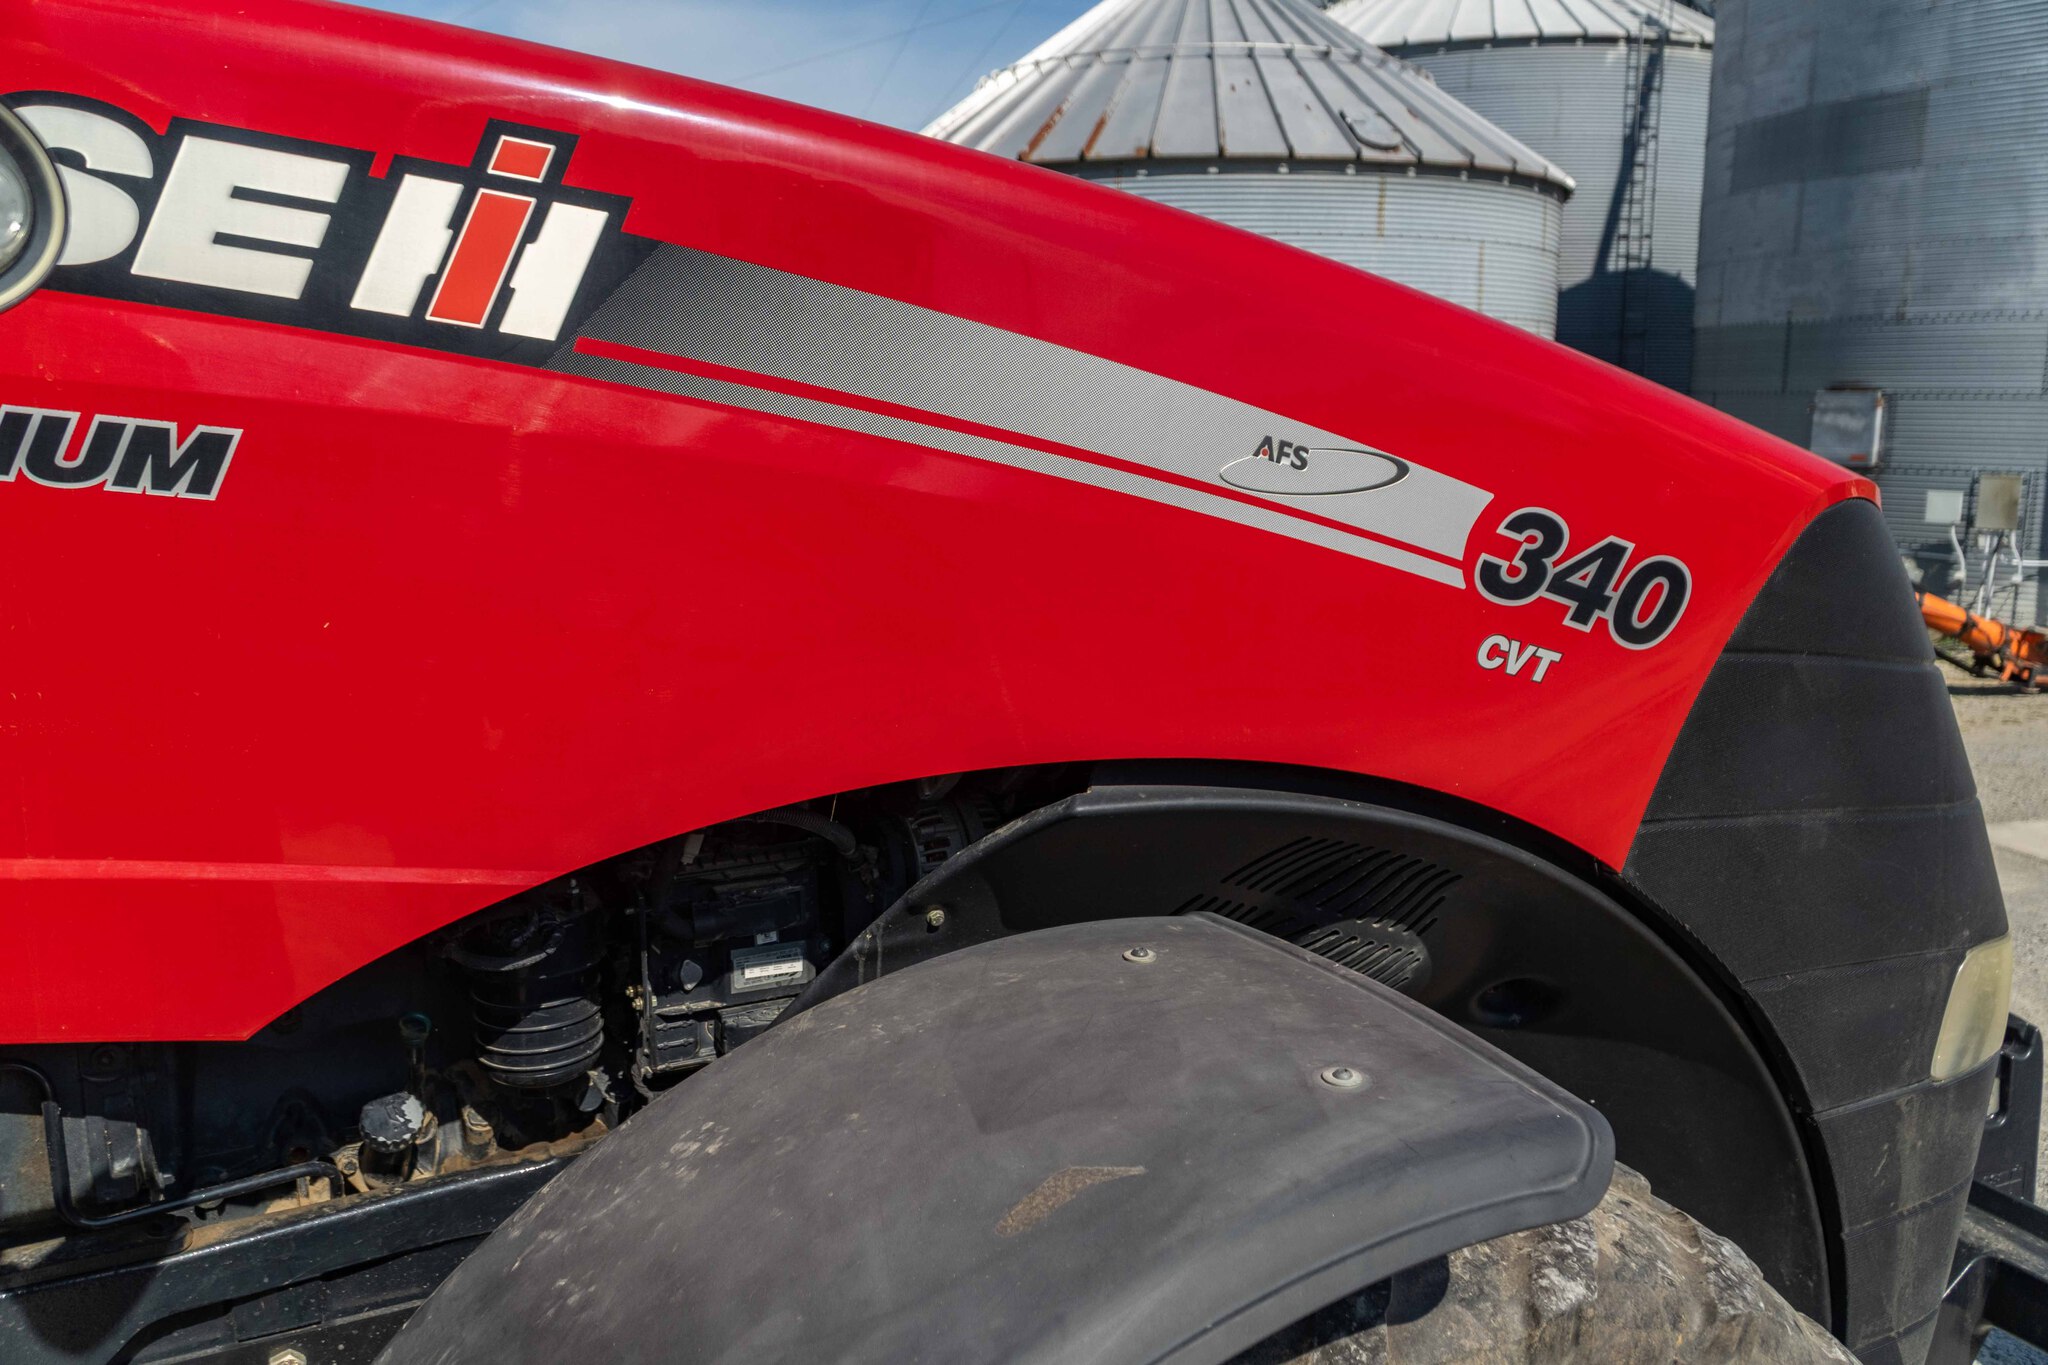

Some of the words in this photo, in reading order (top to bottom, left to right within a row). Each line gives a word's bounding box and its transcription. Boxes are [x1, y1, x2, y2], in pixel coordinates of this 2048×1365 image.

[0, 404, 244, 501] IUM
[1252, 435, 1310, 471] AFS
[1474, 507, 1692, 650] 340
[1477, 634, 1563, 683] CVT
